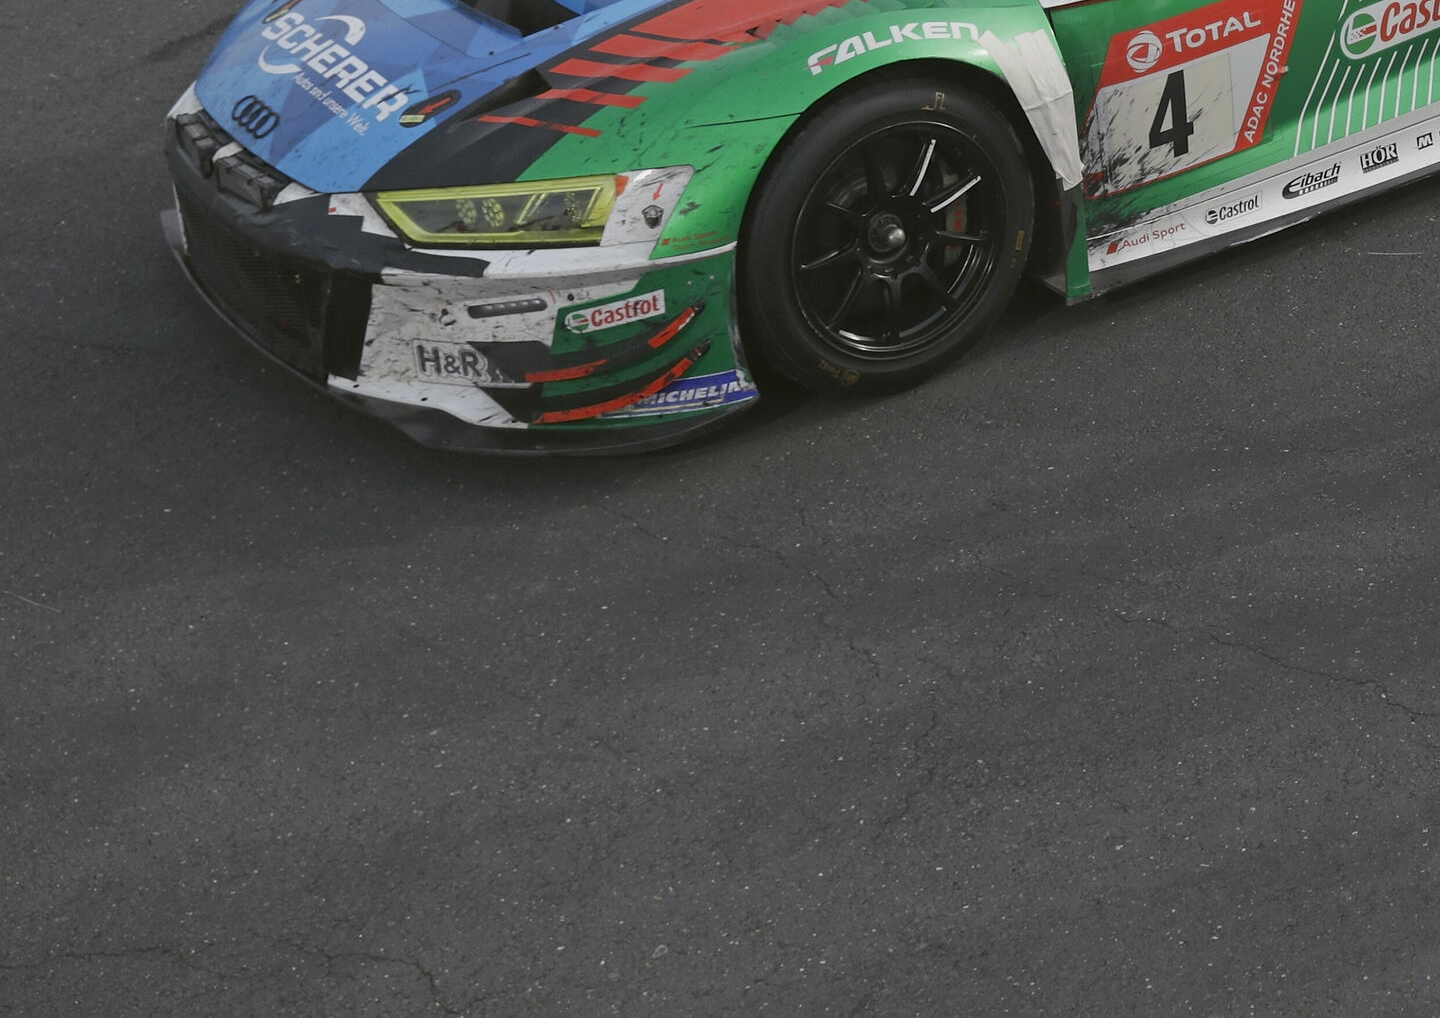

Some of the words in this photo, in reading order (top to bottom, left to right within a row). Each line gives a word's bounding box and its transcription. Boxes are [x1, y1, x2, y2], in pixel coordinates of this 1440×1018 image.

[806, 22, 980, 76] FALKEN
[1165, 11, 1262, 53] TOTAL
[261, 12, 409, 123] SCHERER
[1149, 68, 1194, 158] 4
[1243, 91, 1268, 144] ADAC
[1361, 142, 1398, 169] HÖR
[1282, 163, 1342, 200] Eibach
[1219, 195, 1260, 221] Castrol
[1120, 235, 1150, 249] Audi
[1153, 223, 1186, 240] Sport
[591, 295, 660, 328] Castrol
[417, 345, 482, 377] H&R
